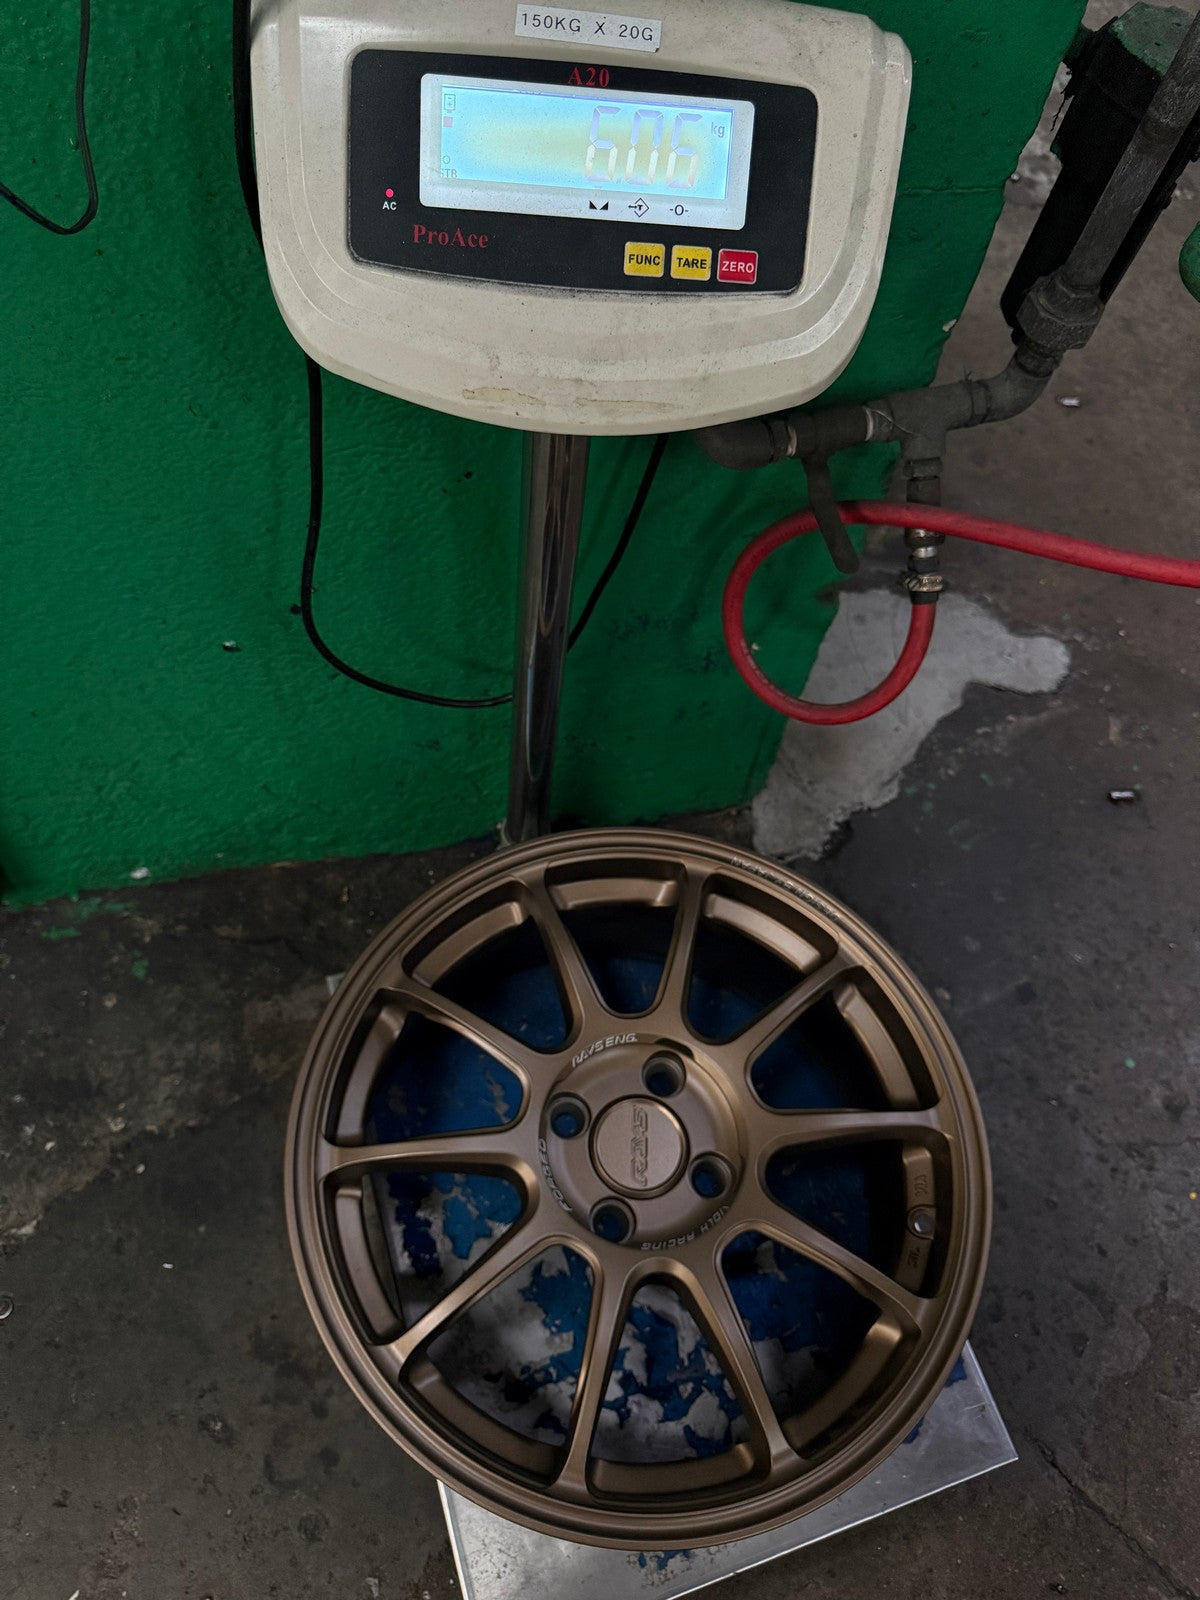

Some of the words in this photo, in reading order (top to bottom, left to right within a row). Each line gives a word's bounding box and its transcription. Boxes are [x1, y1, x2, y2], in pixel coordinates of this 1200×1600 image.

[522, 13, 581, 33] 150KG
[594, 21, 606, 35] X
[618, 24, 653, 42] 20G
[568, 66, 610, 88] A20
[711, 121, 725, 138] kg
[382, 201, 397, 211] AC
[413, 224, 489, 249] ProAce
[628, 253, 660, 266] FUNC
[677, 258, 706, 270] TARE
[722, 262, 754, 275] ZERO
